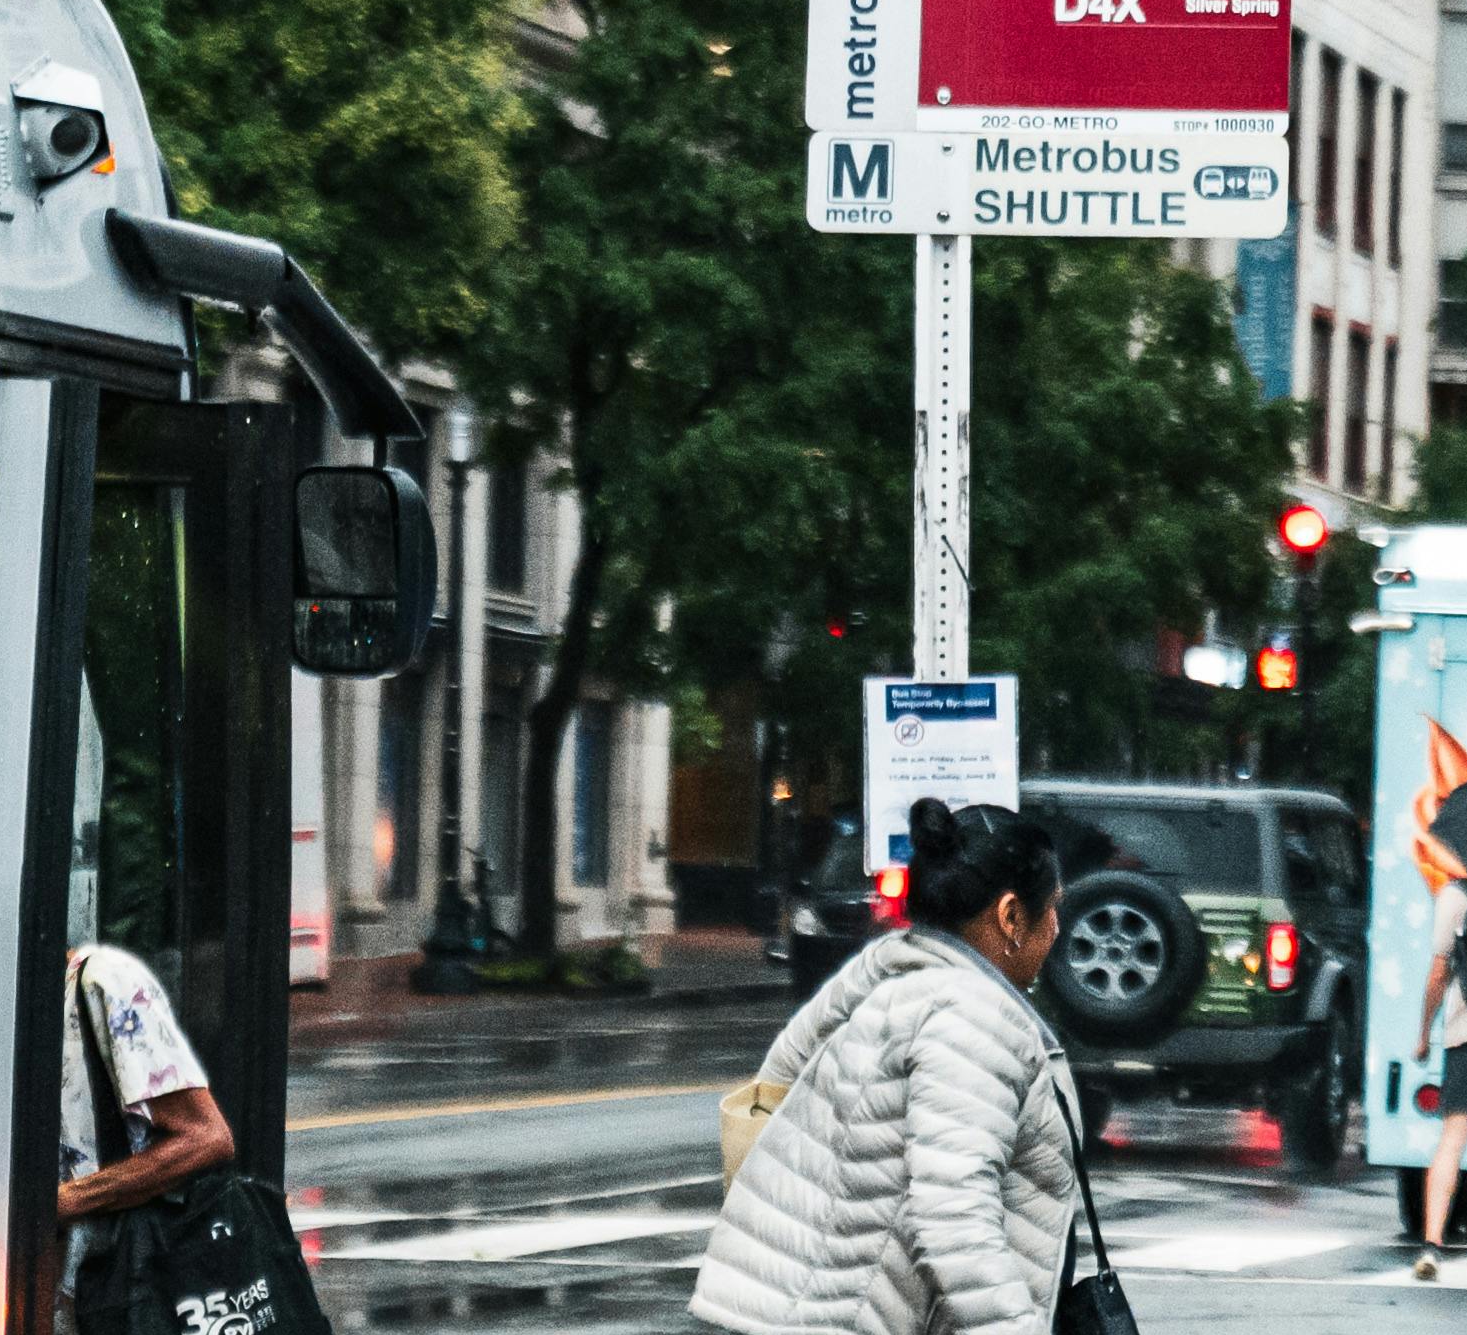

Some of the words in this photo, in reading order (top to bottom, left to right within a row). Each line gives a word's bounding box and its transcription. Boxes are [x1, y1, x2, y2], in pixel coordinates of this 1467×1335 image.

[980, 116, 1119, 131] 202-GO-METRO
[1215, 120, 1275, 134] 1000930
[975, 138, 1181, 174] Metrobus
[832, 143, 890, 200] M
[825, 207, 893, 225] metro
[974, 189, 1187, 226] SHUTTLE
